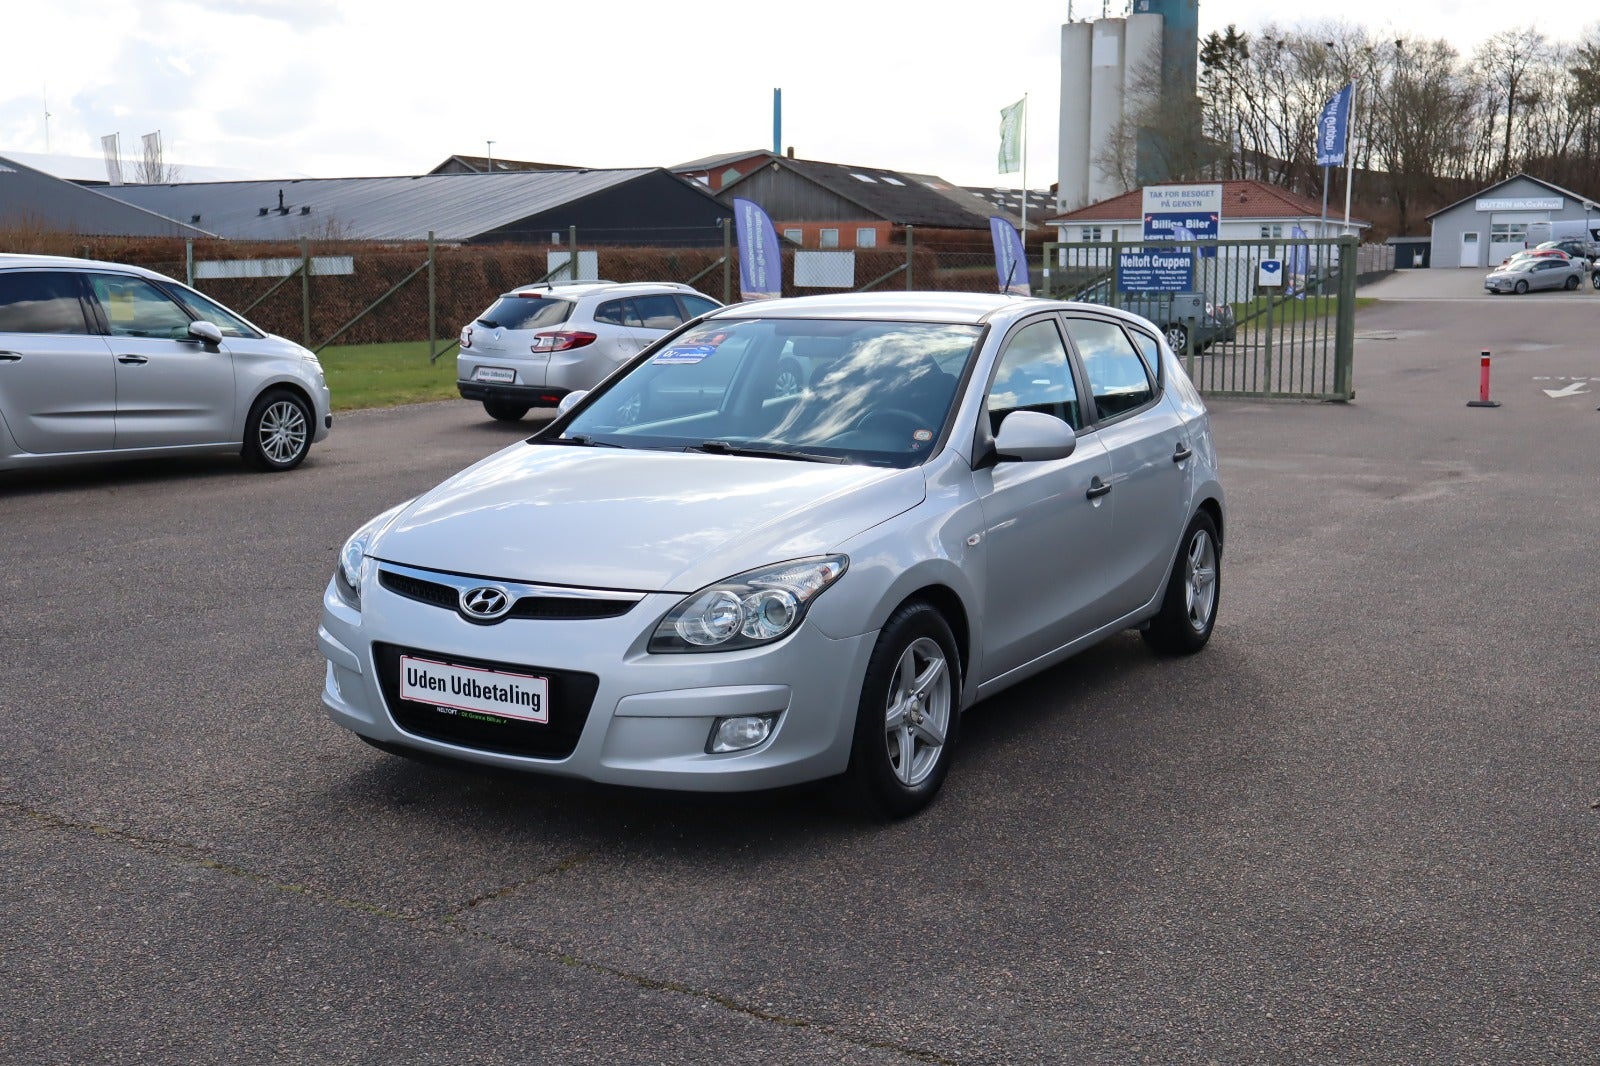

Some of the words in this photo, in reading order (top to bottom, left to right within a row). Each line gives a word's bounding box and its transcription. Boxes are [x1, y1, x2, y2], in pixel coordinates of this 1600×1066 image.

[1181, 190, 1215, 198] BESØGET
[1160, 200, 1171, 208] PÅ
[1172, 200, 1202, 208] GENSYN
[1185, 219, 1210, 229] Biler
[1120, 255, 1150, 268] Neltoft
[1152, 255, 1191, 270] Gruppen
[407, 667, 446, 692] Uden
[451, 675, 541, 713] Udbetaling
[436, 706, 458, 716] NELTOFT
